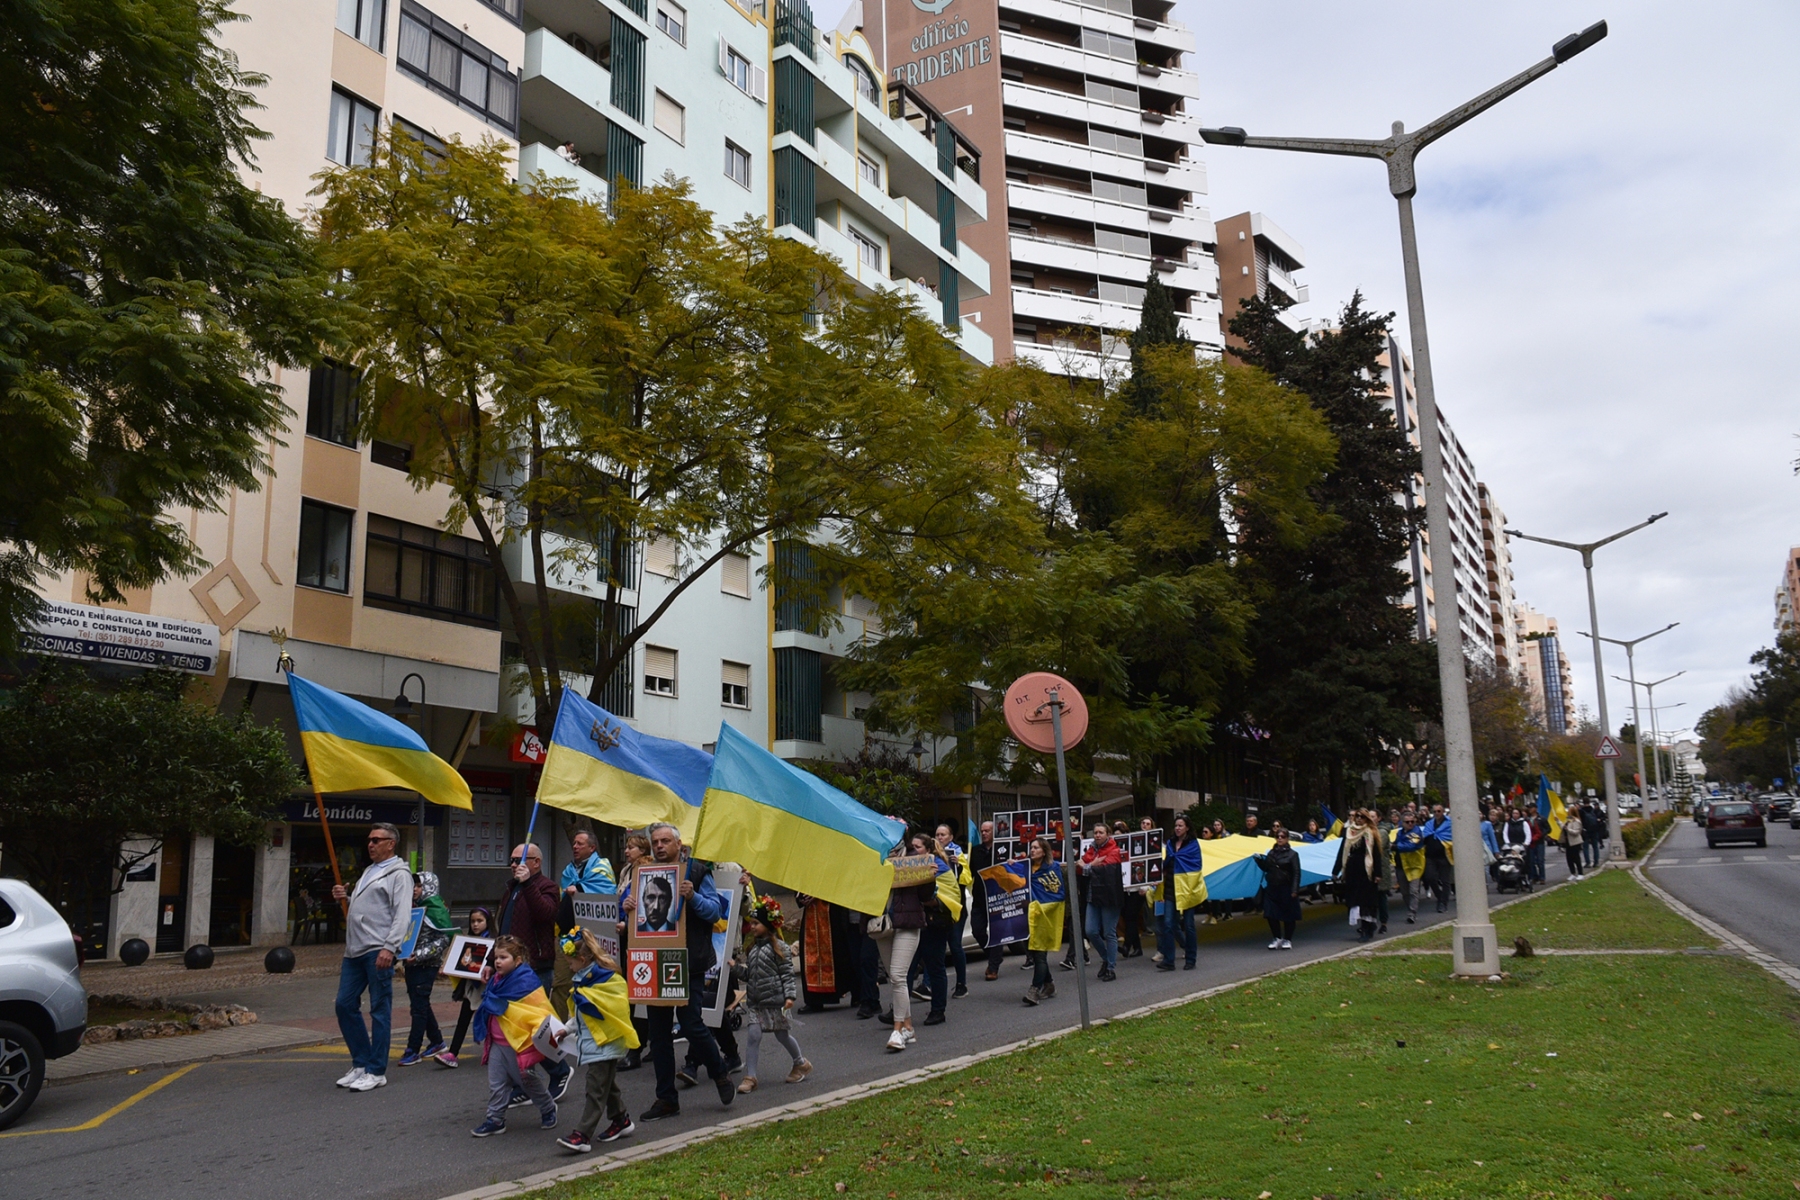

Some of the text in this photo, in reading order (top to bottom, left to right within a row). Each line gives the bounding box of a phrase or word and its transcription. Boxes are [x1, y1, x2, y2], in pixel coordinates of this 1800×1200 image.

[892, 35, 992, 86] TRIDENTE
[82, 620, 88, 628] E
[92, 621, 152, 638] CONSTRUÇÃO
[156, 630, 213, 647] BIOCLIMÁTICA
[146, 620, 159, 629] EM
[162, 622, 203, 636] EDIFÍCIOS
[78, 629, 93, 641] Tel:
[95, 633, 116, 643] (351)
[118, 635, 133, 645] 289
[150, 639, 165, 649] 230
[99, 644, 155, 663] VIVENDAS
[172, 653, 205, 670] TÉNIS
[303, 802, 373, 820] Leonidas
[574, 902, 617, 919] OBRIGADO
[631, 951, 654, 962] NEVER
[662, 951, 682, 961] 2022
[633, 987, 653, 997] 1939
[661, 987, 686, 997] AGAIN
